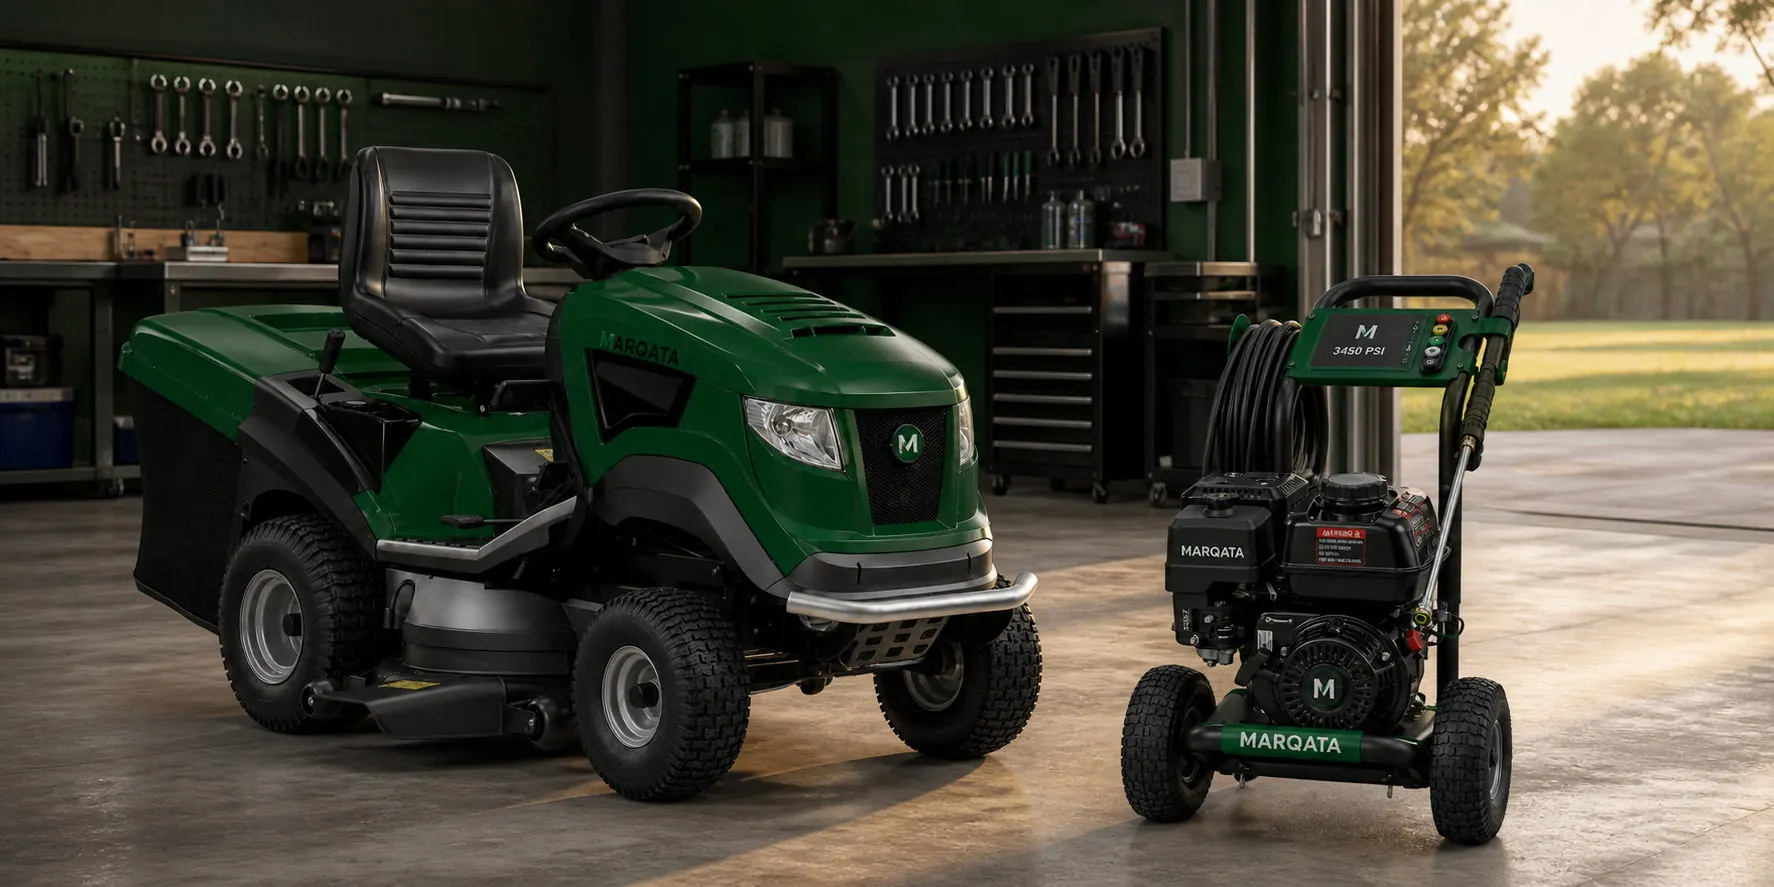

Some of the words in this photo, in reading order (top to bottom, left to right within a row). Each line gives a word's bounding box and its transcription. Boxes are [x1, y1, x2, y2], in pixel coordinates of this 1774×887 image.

[1355, 325, 1378, 339] M
[600, 331, 679, 366] MARQATA
[1333, 346, 1363, 356] 3450
[1365, 346, 1386, 356] PSI
[898, 433, 918, 454] M
[1181, 545, 1245, 558] MARQATA
[1313, 678, 1335, 699] M
[1240, 731, 1342, 754] MARQATA
